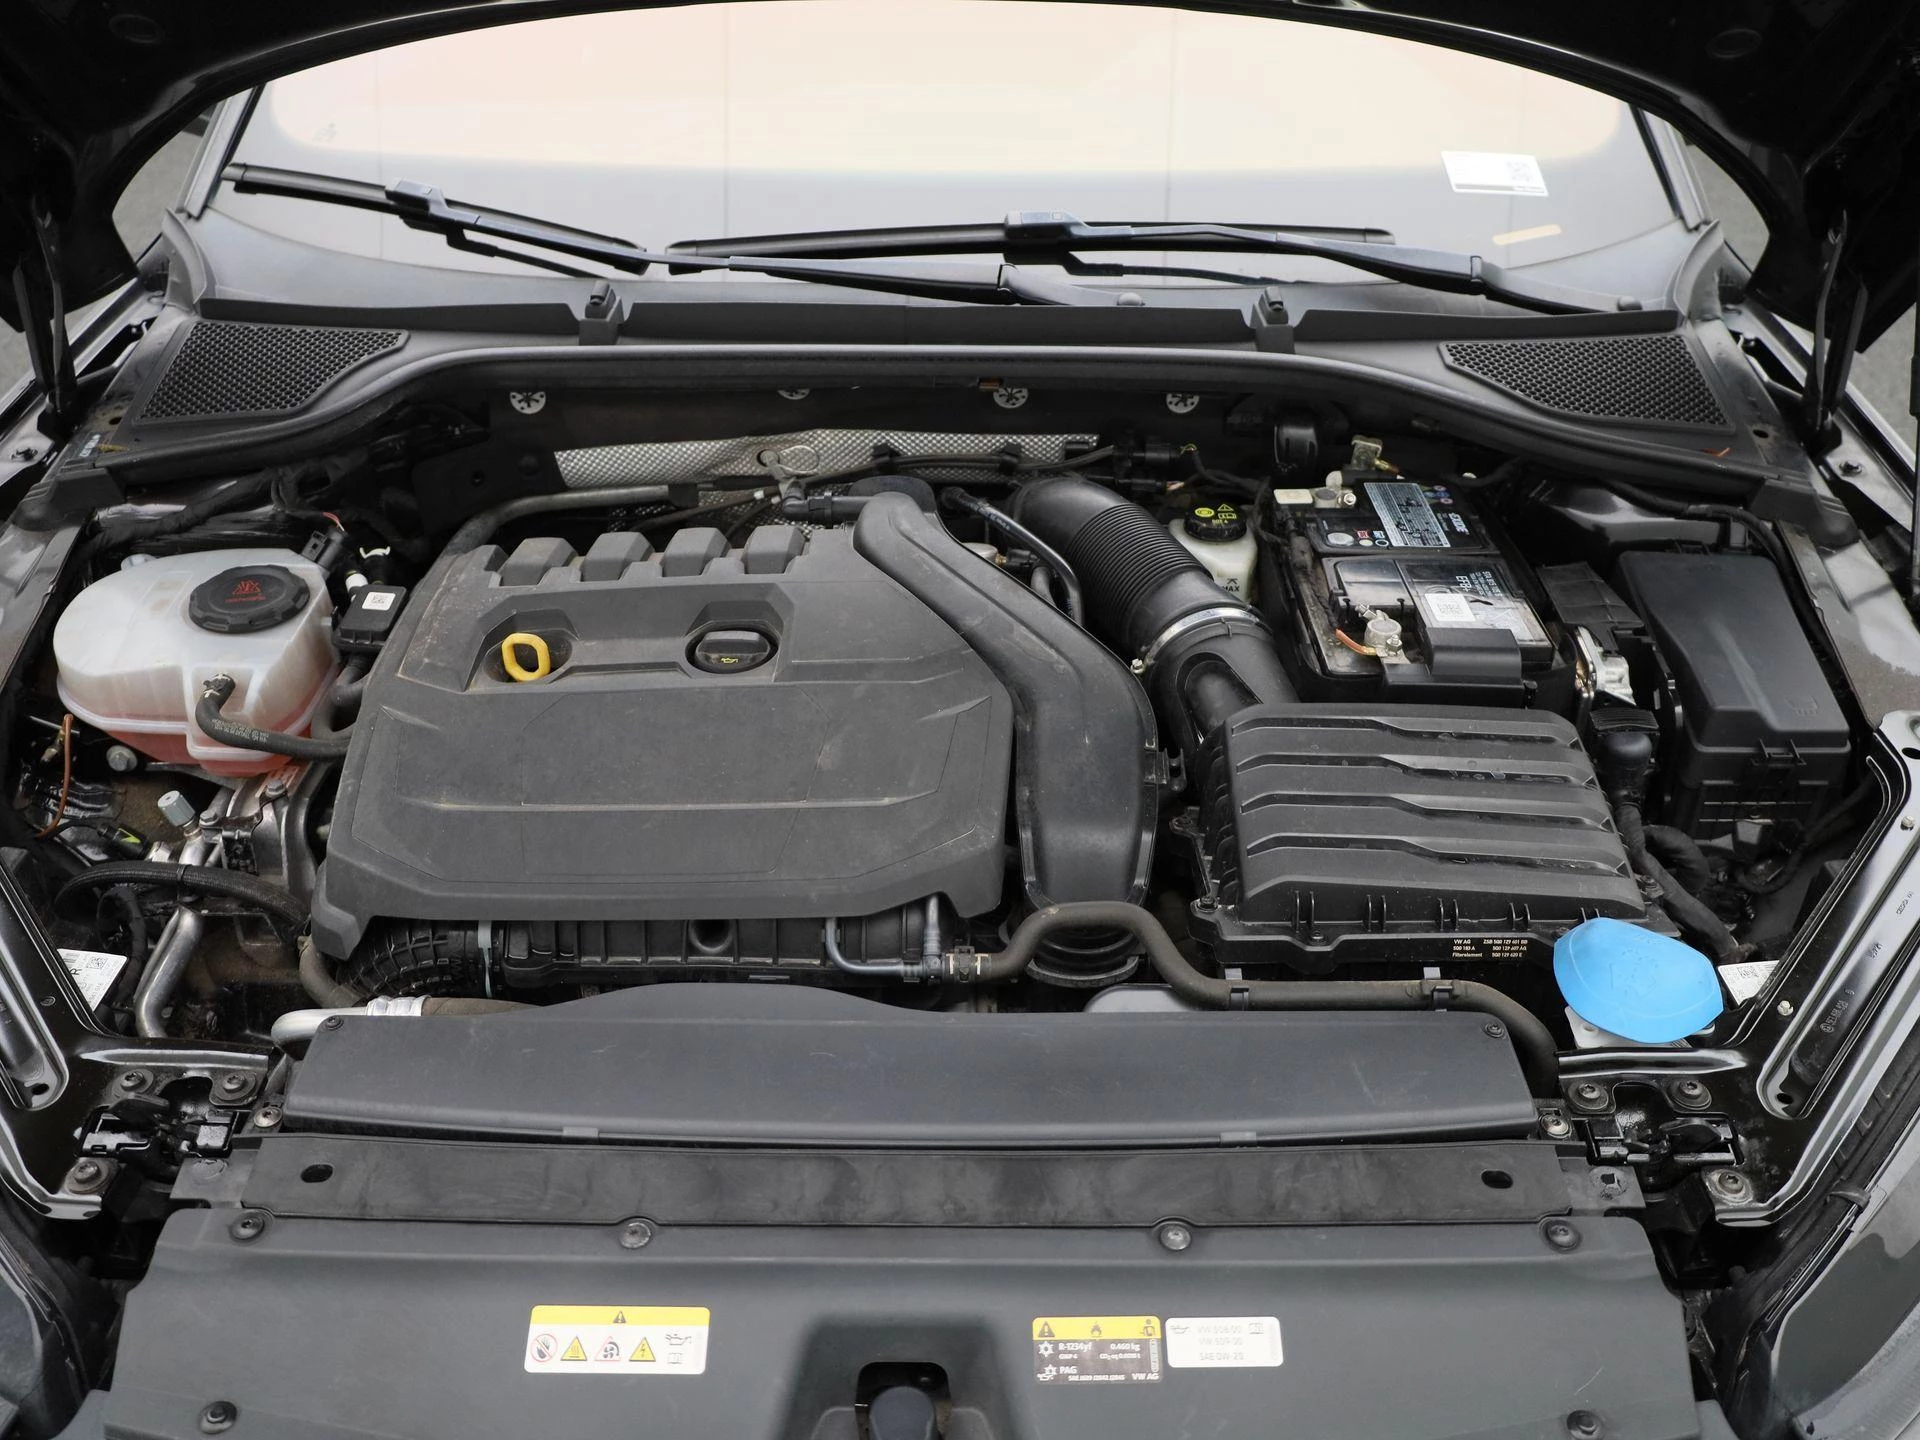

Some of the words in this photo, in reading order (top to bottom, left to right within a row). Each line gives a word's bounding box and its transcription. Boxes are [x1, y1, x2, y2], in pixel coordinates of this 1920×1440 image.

[1058, 1342, 1092, 1352] R-1234yf
[1130, 1342, 1141, 1351] kg
[1199, 1352, 1214, 1360] SAE
[1059, 1366, 1077, 1374] PAG
[1131, 1373, 1146, 1381] VW
